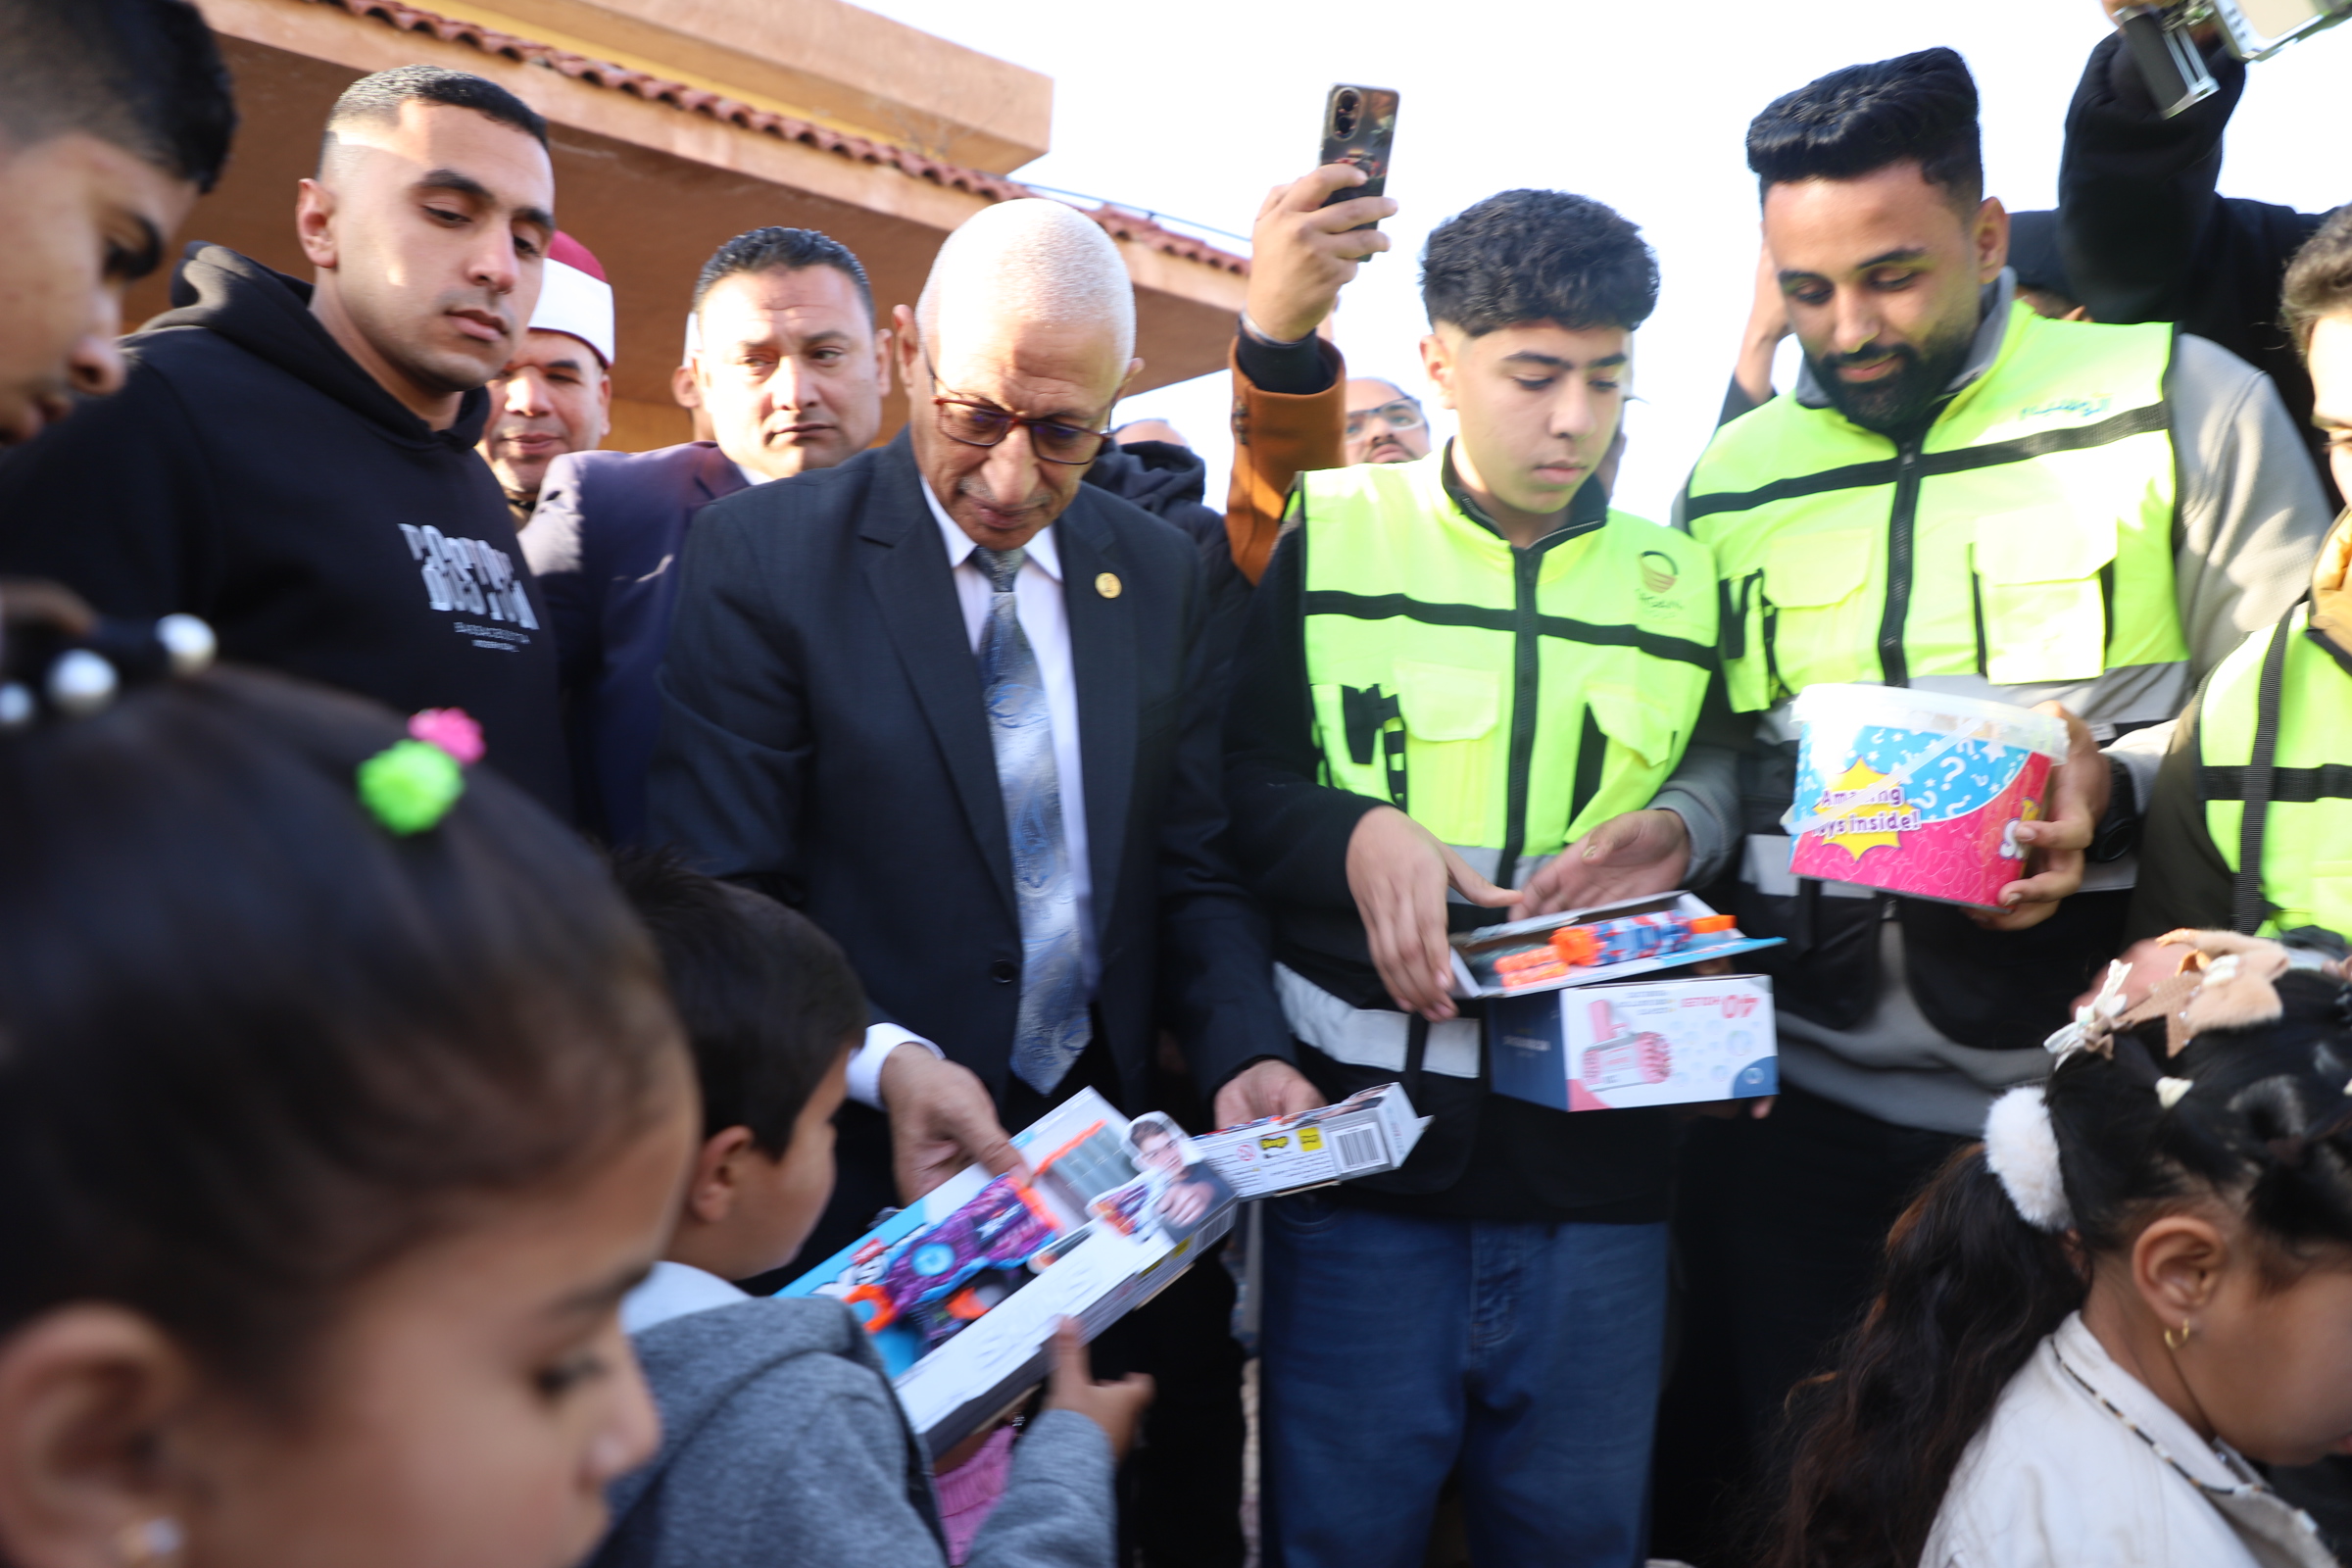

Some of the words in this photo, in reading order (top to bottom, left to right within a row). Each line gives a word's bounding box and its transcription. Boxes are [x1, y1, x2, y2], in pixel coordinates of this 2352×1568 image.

[1823, 788, 1903, 807] Amng
[1812, 819, 1846, 838] oys
[1848, 809, 1921, 833] inside!
